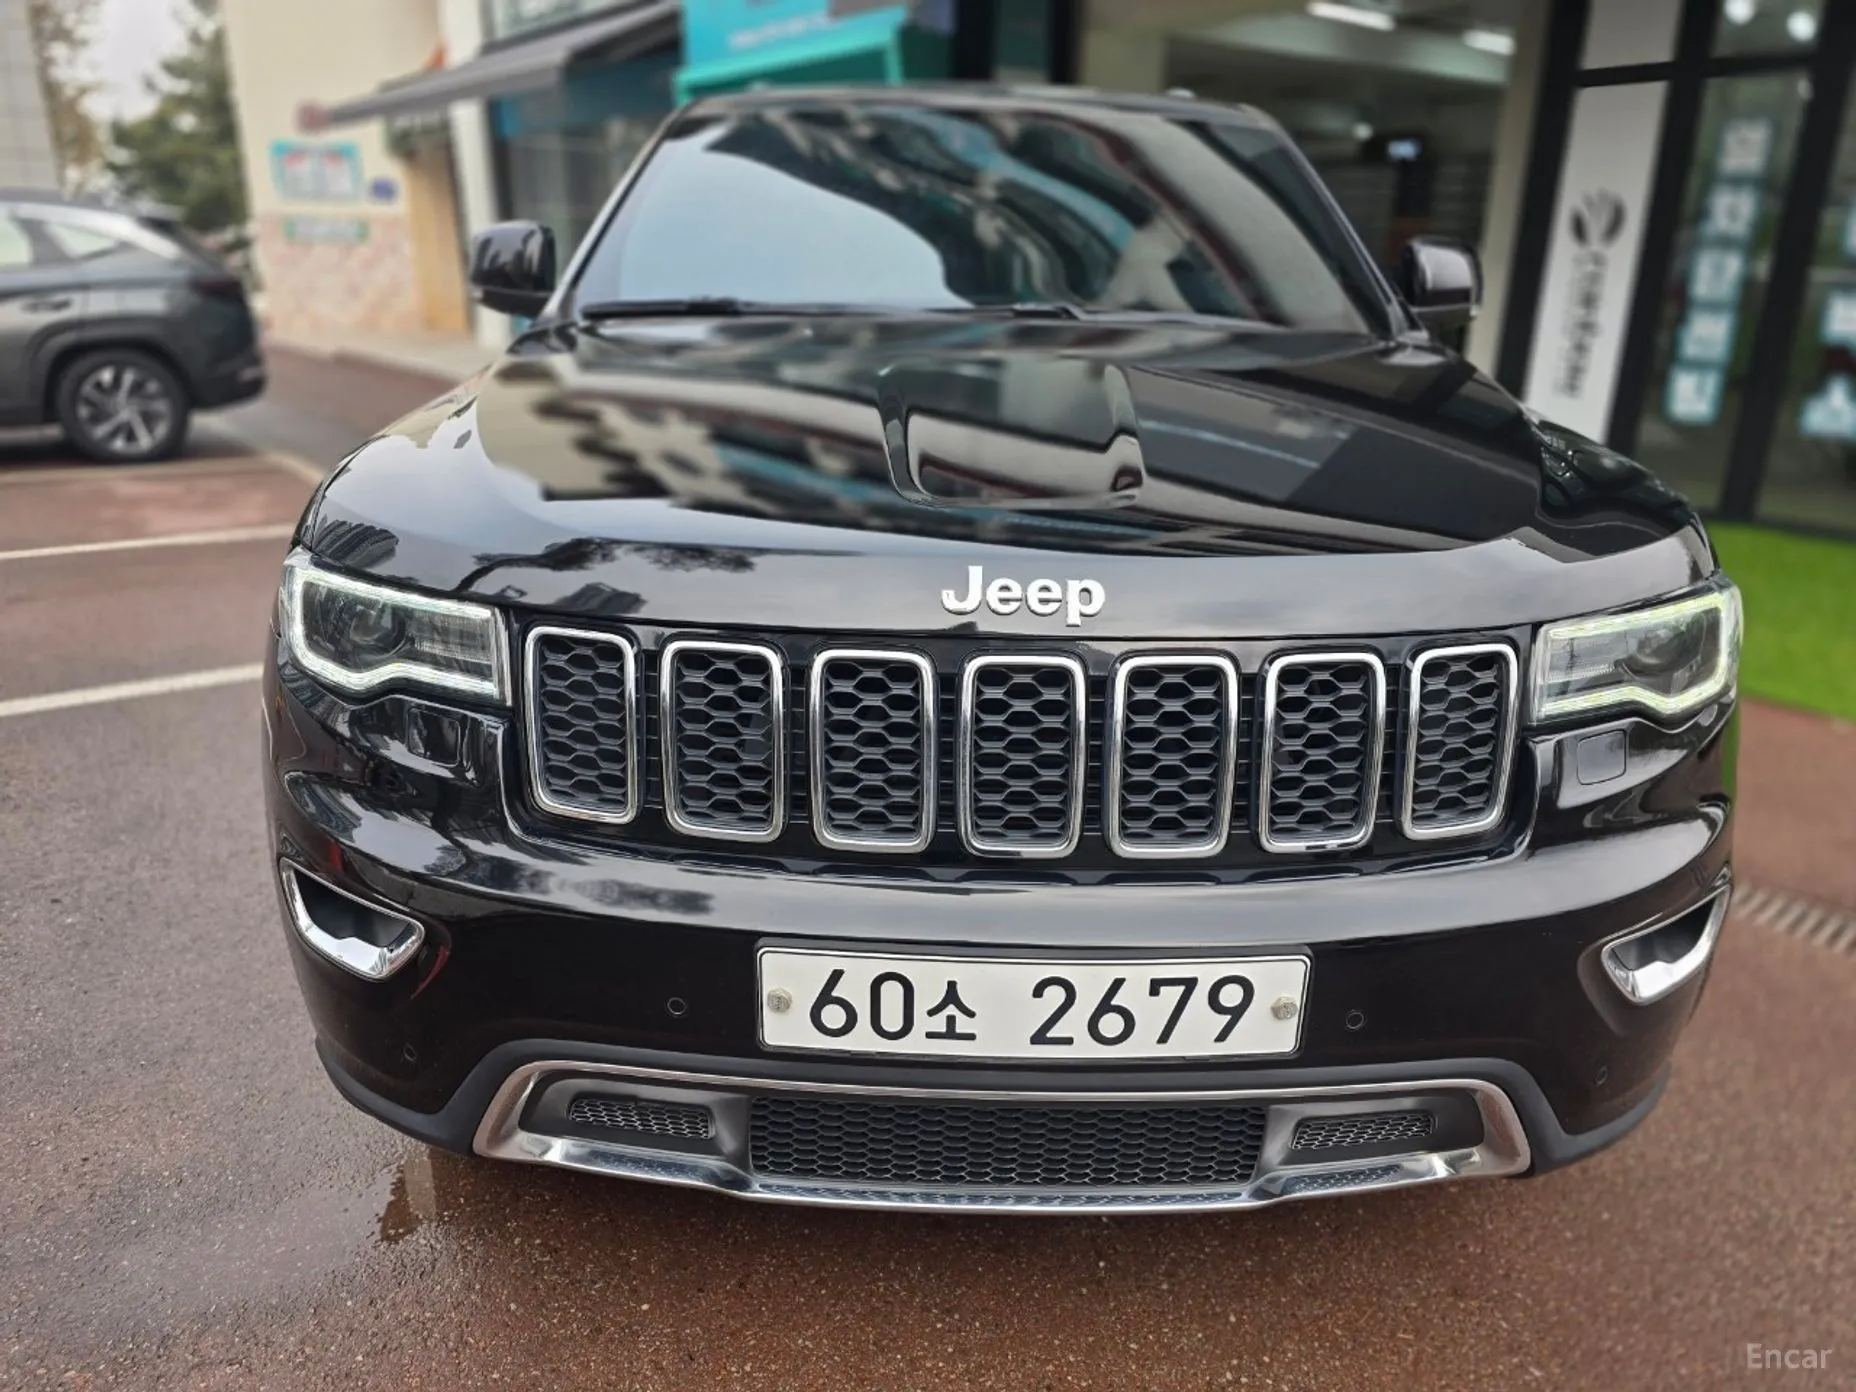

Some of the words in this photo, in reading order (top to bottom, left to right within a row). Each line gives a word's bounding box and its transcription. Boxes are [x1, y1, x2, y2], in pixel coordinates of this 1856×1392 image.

[941, 565, 1106, 627] Jeep
[809, 969, 977, 1041] 60소
[1029, 974, 1256, 1046] 2679
